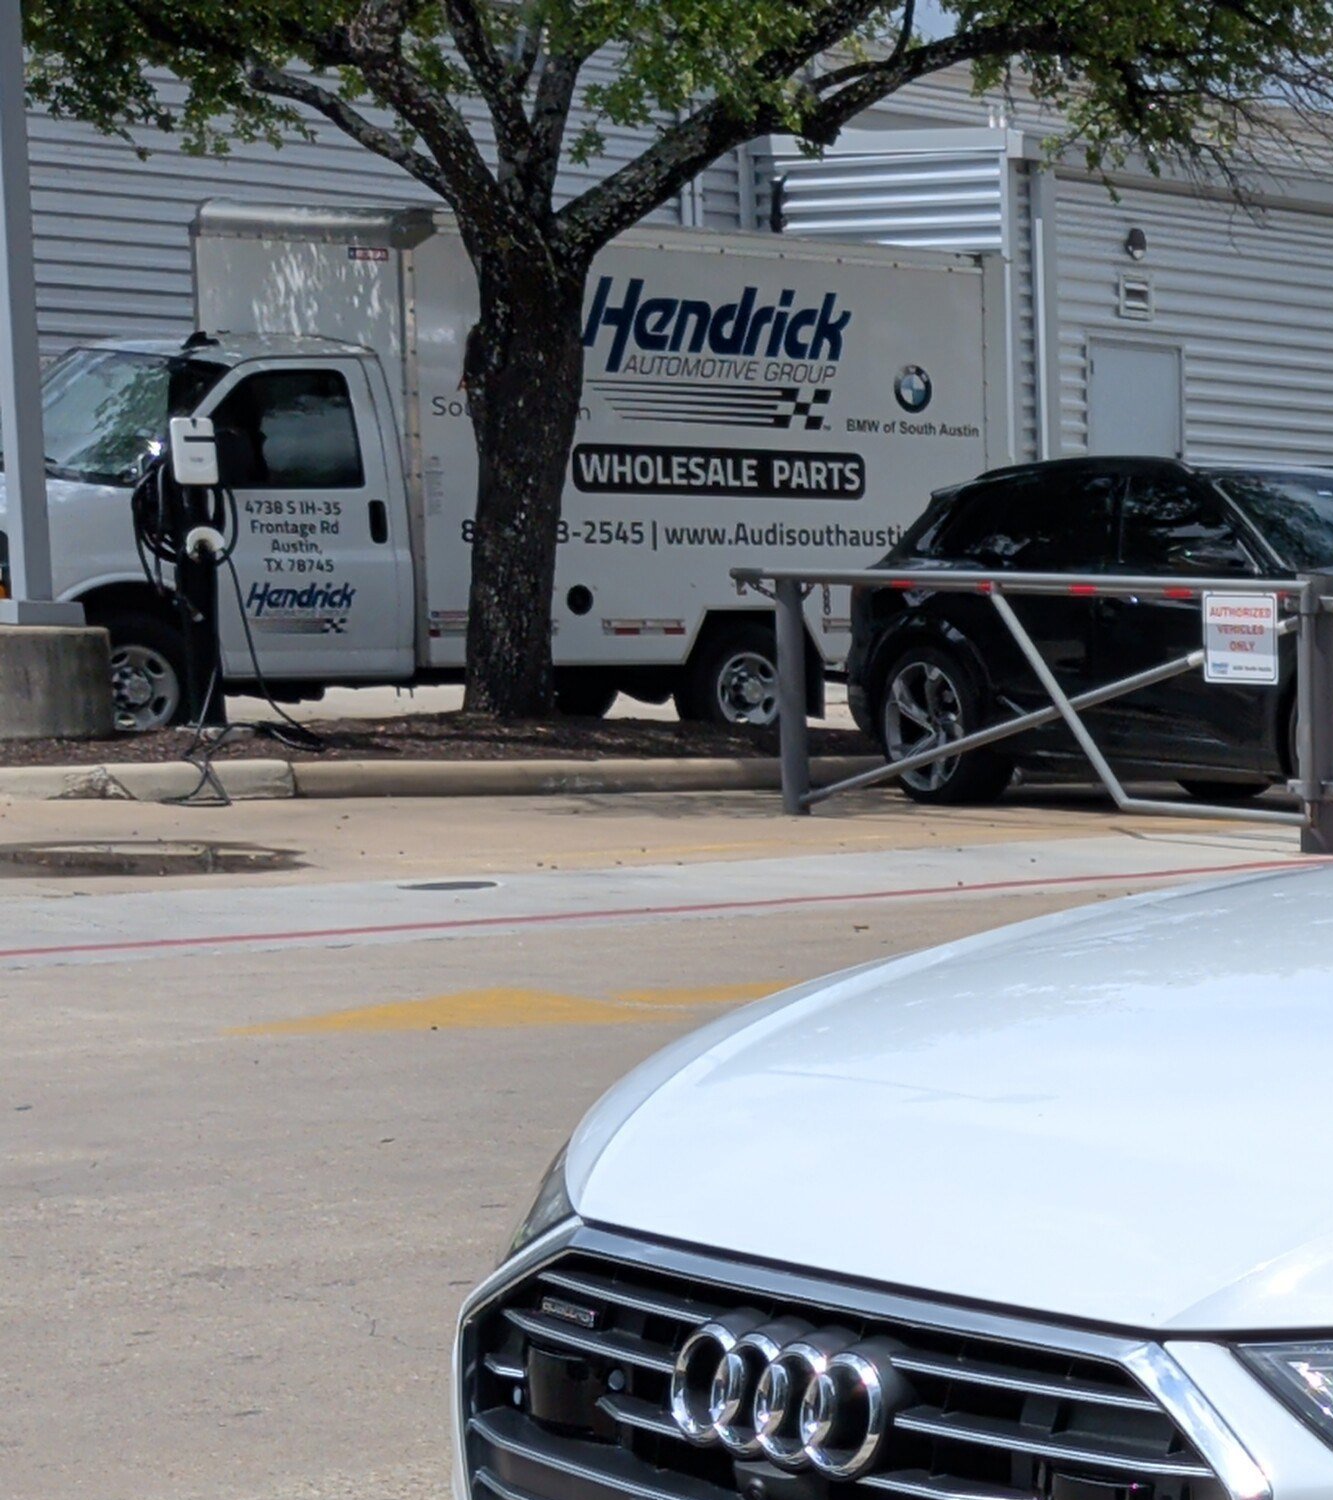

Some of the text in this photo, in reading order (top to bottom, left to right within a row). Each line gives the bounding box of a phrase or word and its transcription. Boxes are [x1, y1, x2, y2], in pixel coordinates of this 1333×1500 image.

[584, 276, 851, 372] Hendrick
[622, 354, 836, 384] AUTOMOTIVE GROUP
[846, 419, 880, 433] BMW
[883, 421, 896, 434] of
[900, 421, 936, 436] South
[939, 423, 979, 437] Austin
[579, 453, 861, 491] WHOLESALE PARTS
[245, 500, 342, 516] 4738 S IH-35
[250, 520, 339, 538] Frontage Rd
[664, 522, 908, 548] www.Audisouthausti
[271, 539, 323, 554] Austin,
[264, 558, 335, 573] TX 78745
[246, 582, 357, 617] Hendrick
[1210, 607, 1271, 618] AUTHORIZED
[1217, 624, 1264, 635] VEHICLES
[1230, 641, 1255, 652] ONLY
